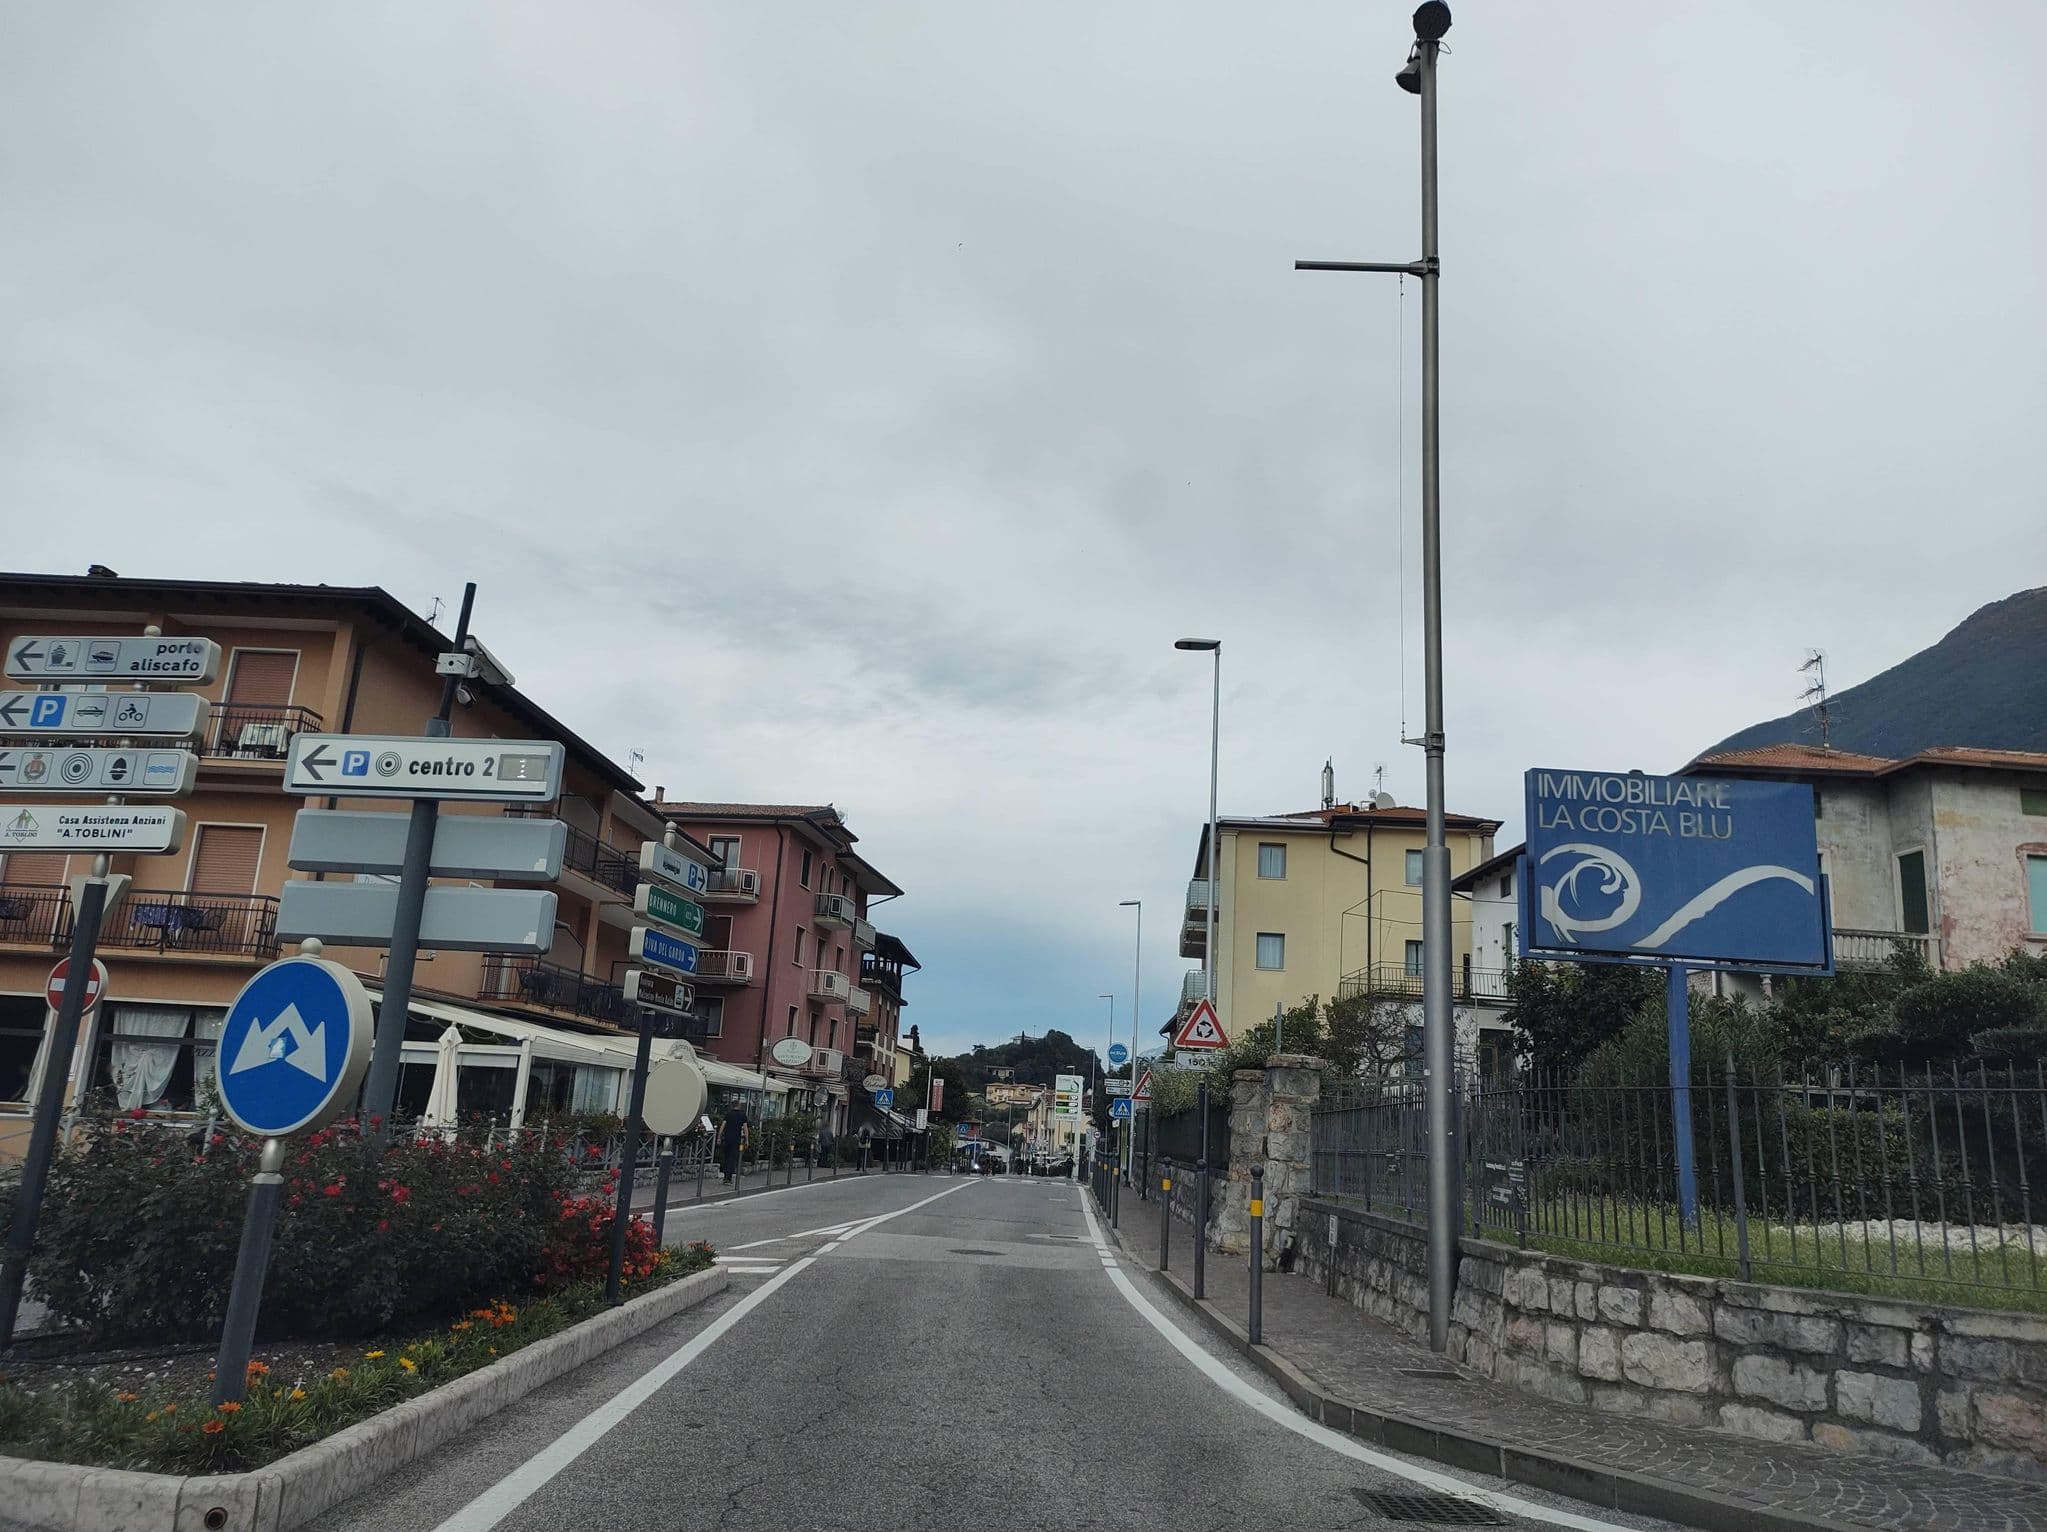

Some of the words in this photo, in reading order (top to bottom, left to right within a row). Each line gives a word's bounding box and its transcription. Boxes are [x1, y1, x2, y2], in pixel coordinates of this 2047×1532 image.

[156, 642, 204, 656] porto
[130, 659, 199, 671] aliscafo
[40, 700, 58, 722] P
[348, 754, 365, 773] P
[409, 756, 475, 776] centro
[482, 757, 494, 777] 2
[1538, 773, 1731, 809] IMMOBILIARE
[59, 816, 79, 824] Casa
[82, 816, 129, 825] Assistenza
[132, 816, 166, 825] Anziani
[1539, 804, 1575, 830] LA
[1579, 807, 1671, 836] COSTA
[1680, 812, 1733, 839] BLU
[57, 829, 133, 838] "A.TOBLINI"
[649, 893, 677, 916] BRENNERO
[645, 936, 658, 953] RIVA
[658, 942, 668, 957] DEL
[669, 946, 685, 961] GARDA
